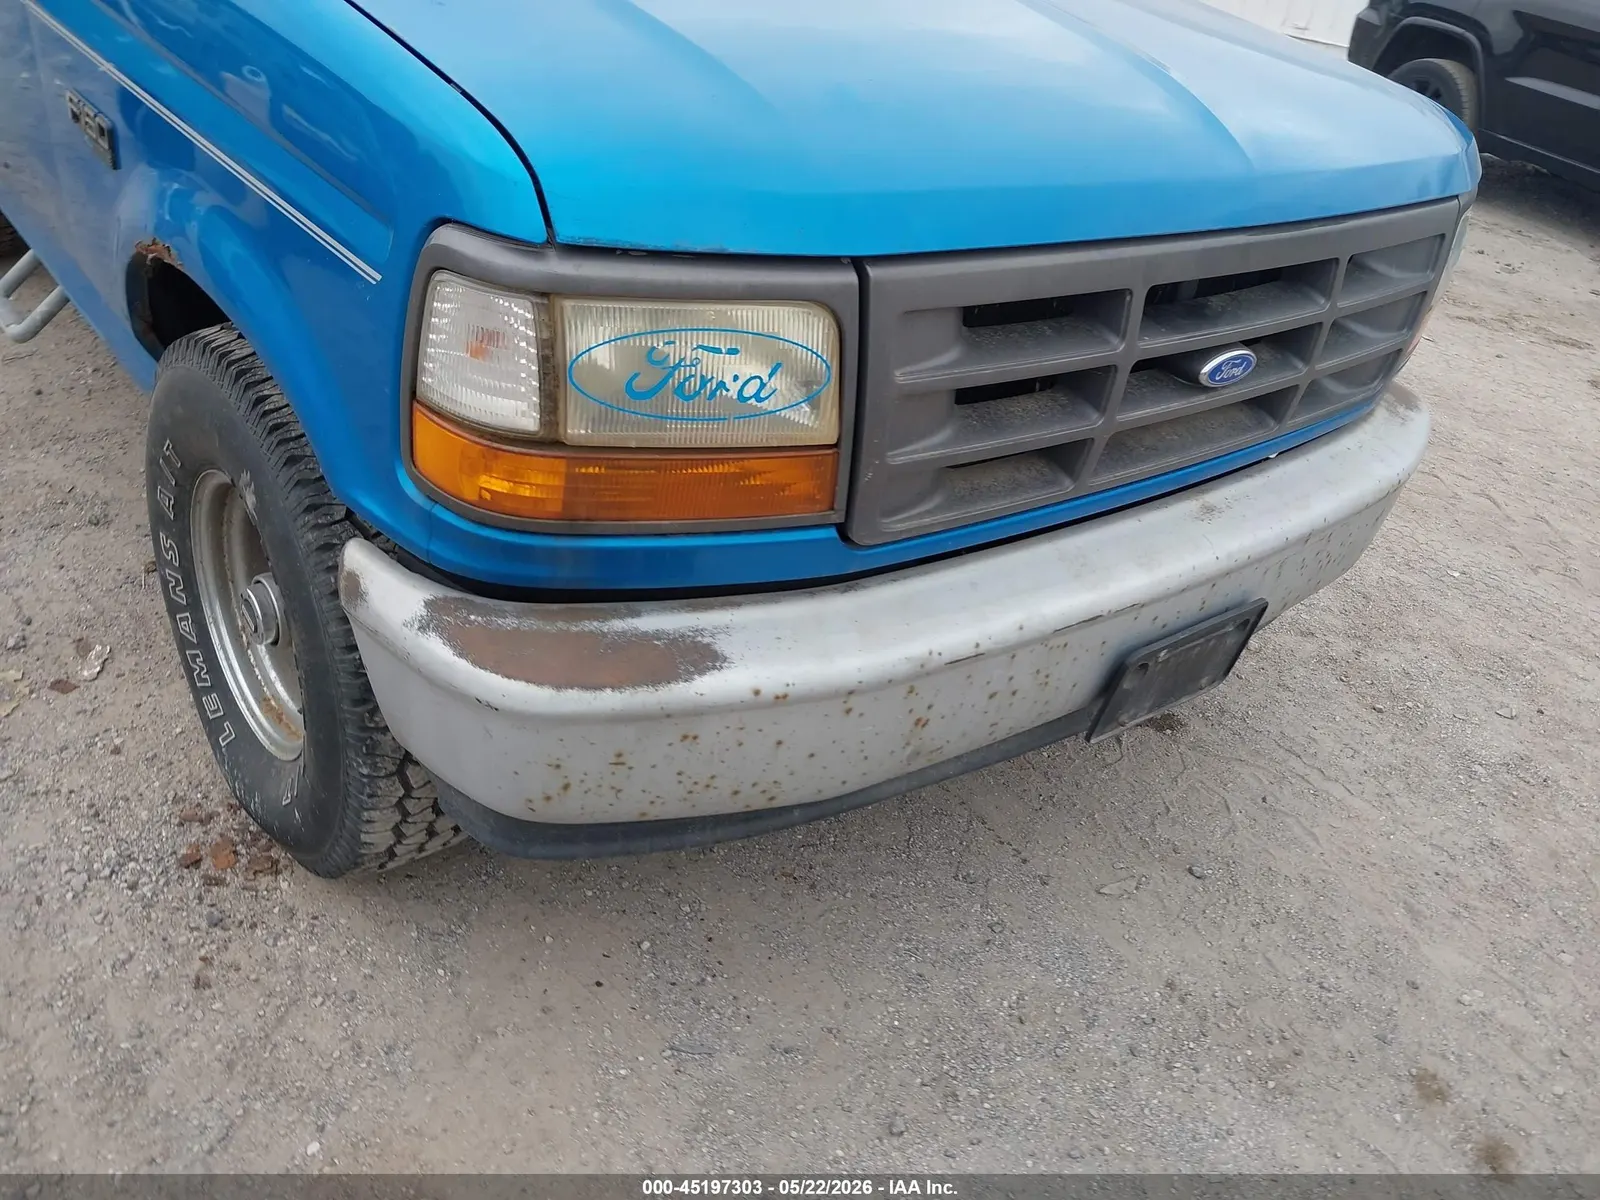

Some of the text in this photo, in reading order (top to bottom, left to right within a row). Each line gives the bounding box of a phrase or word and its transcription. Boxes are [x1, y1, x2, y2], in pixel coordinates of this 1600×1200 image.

[624, 339, 784, 405] Ford
[1215, 358, 1247, 381] Ford
[157, 437, 236, 747] LEMANS A/T
